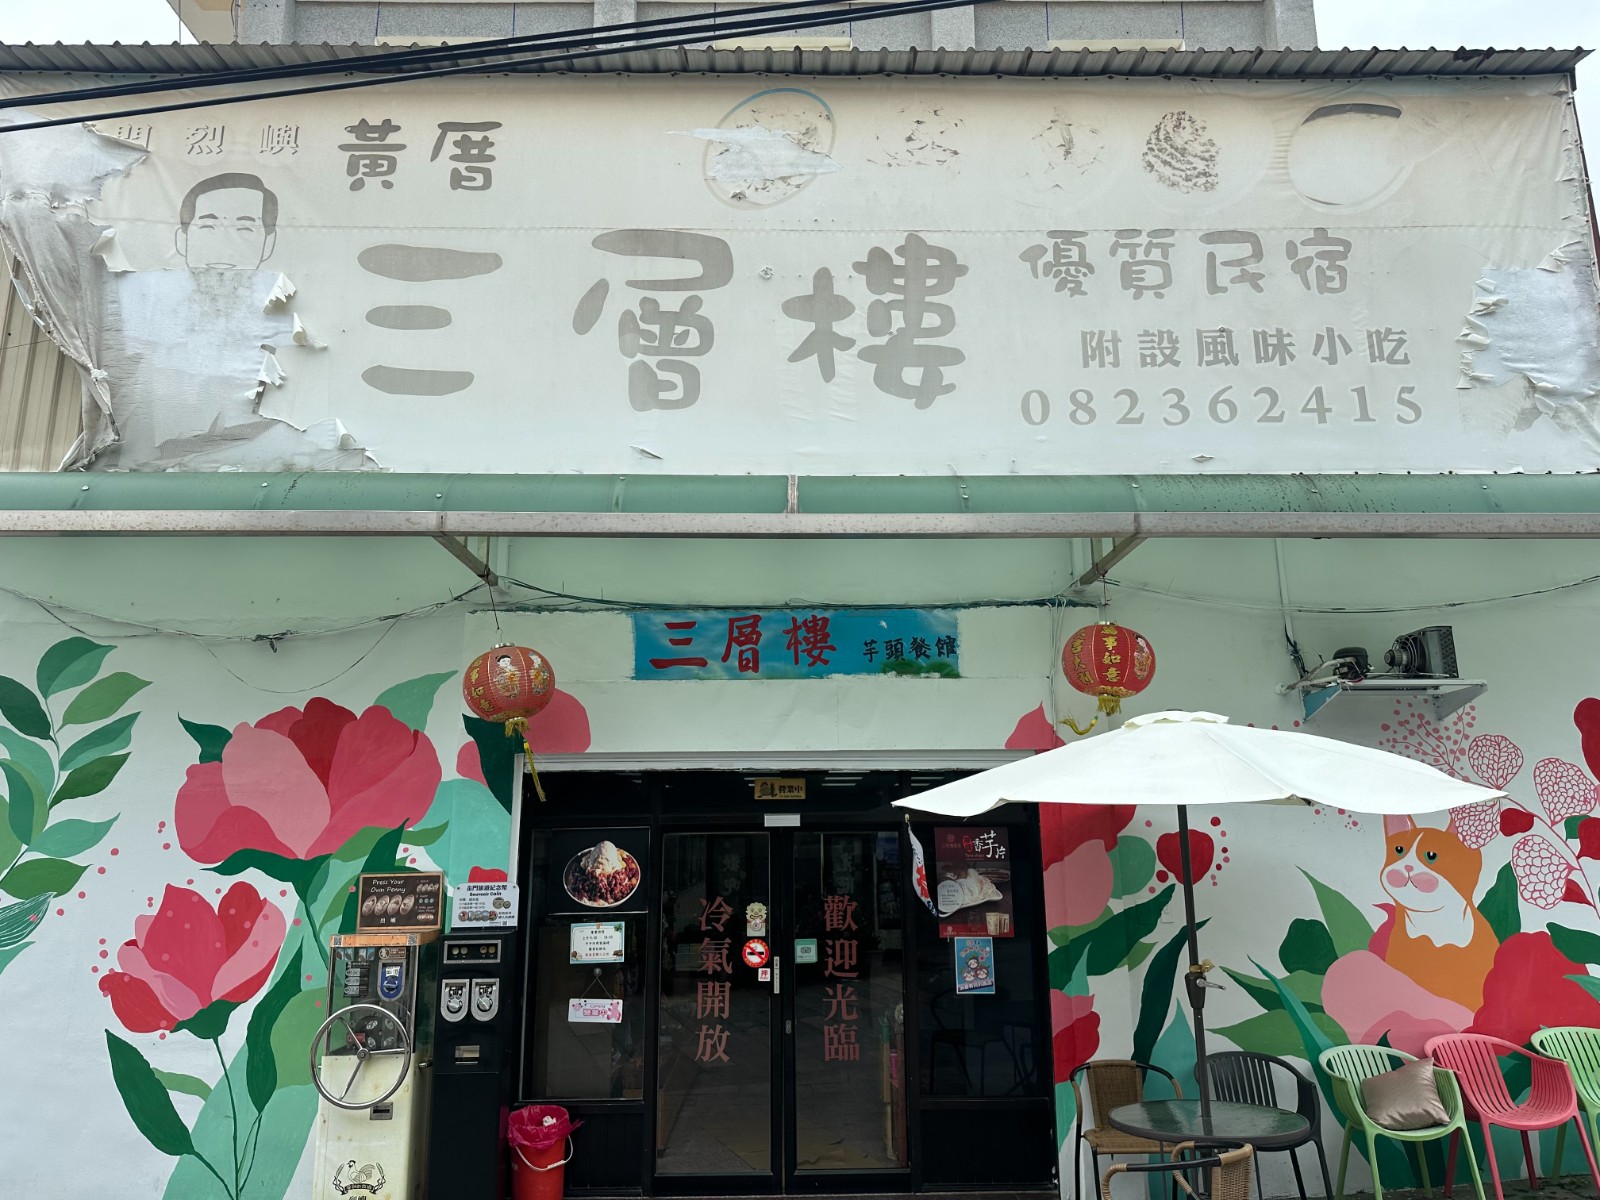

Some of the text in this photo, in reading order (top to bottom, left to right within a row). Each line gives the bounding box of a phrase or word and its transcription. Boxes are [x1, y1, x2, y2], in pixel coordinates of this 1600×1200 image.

[1018, 227, 1352, 300] 優質民宿
[357, 229, 969, 412] 三層樓
[1080, 326, 1412, 370] 附設風味小吃
[1020, 385, 1423, 426] 082362415
[649, 613, 958, 674] 三層樓 芋頭餐館
[386, 886, 406, 894] Penny
[694, 896, 735, 1063] 冷氣開放
[822, 895, 860, 1063] 歡迎光臨
